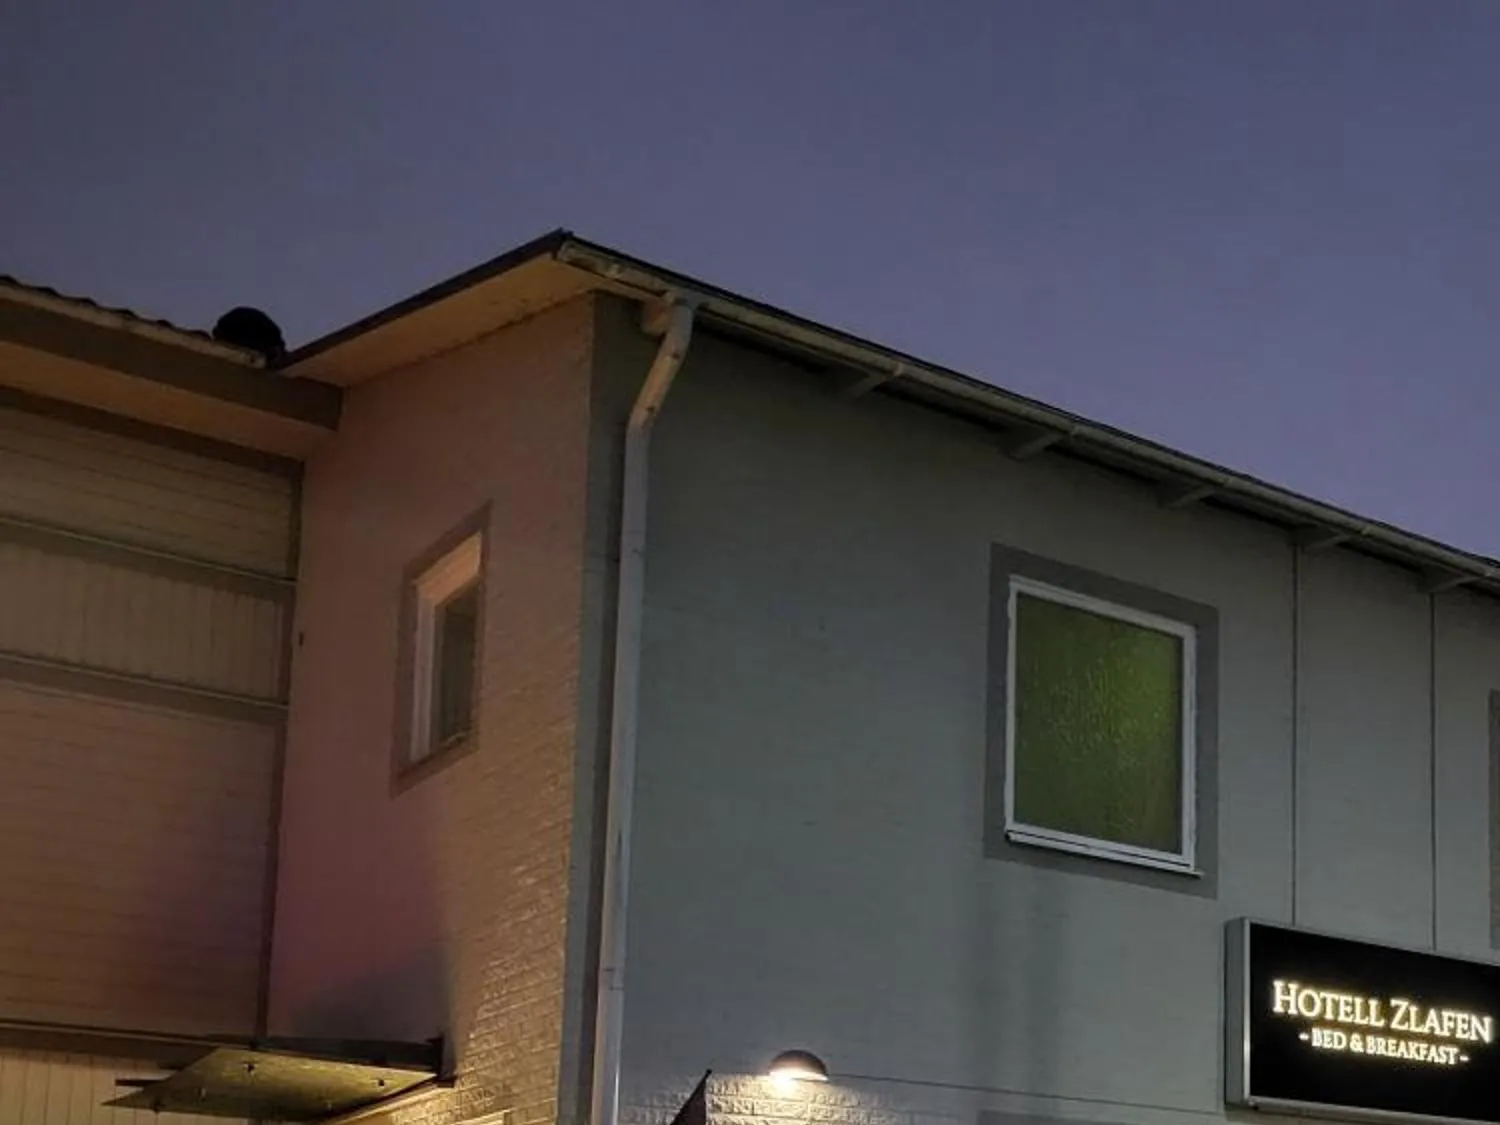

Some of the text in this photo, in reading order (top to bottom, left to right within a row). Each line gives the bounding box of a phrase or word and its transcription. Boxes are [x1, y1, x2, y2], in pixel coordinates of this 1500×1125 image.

[1272, 979, 1493, 1044] HOTELL ZLAFEN
[1311, 1027, 1459, 1065] BED & BREAKFAST
